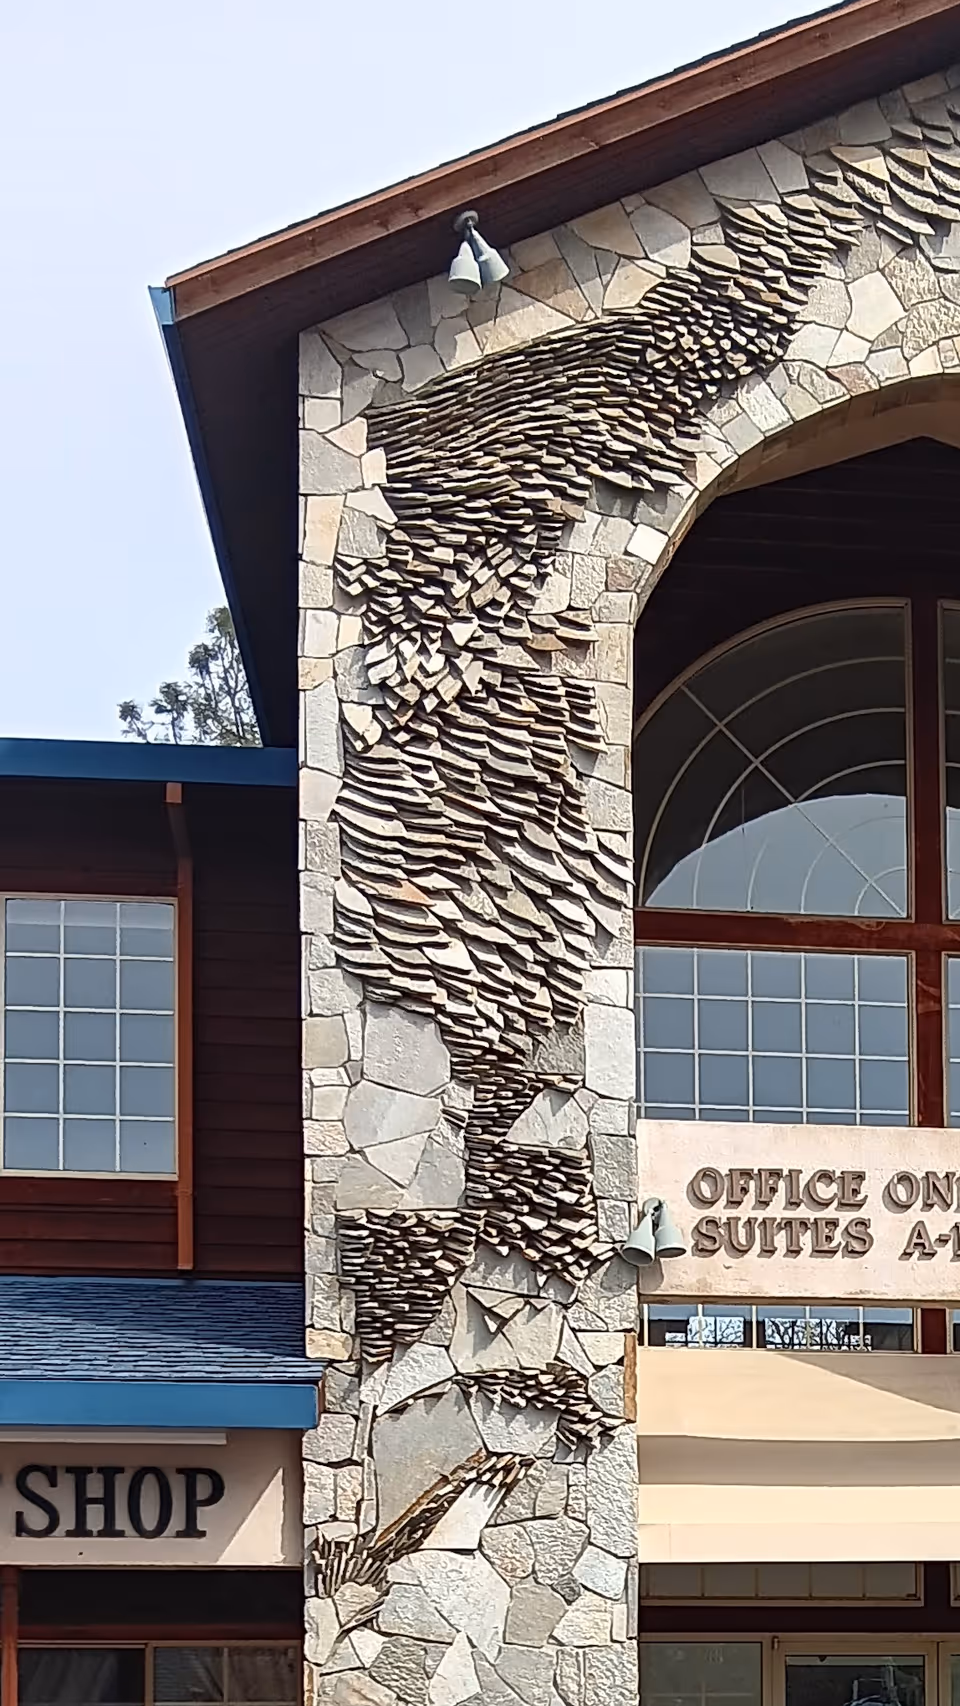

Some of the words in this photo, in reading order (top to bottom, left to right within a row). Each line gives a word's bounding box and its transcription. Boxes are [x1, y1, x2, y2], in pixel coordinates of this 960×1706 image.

[688, 1167, 868, 1209] OFFICE
[692, 1216, 874, 1257] SUITES
[15, 1464, 225, 1538] SHOP
